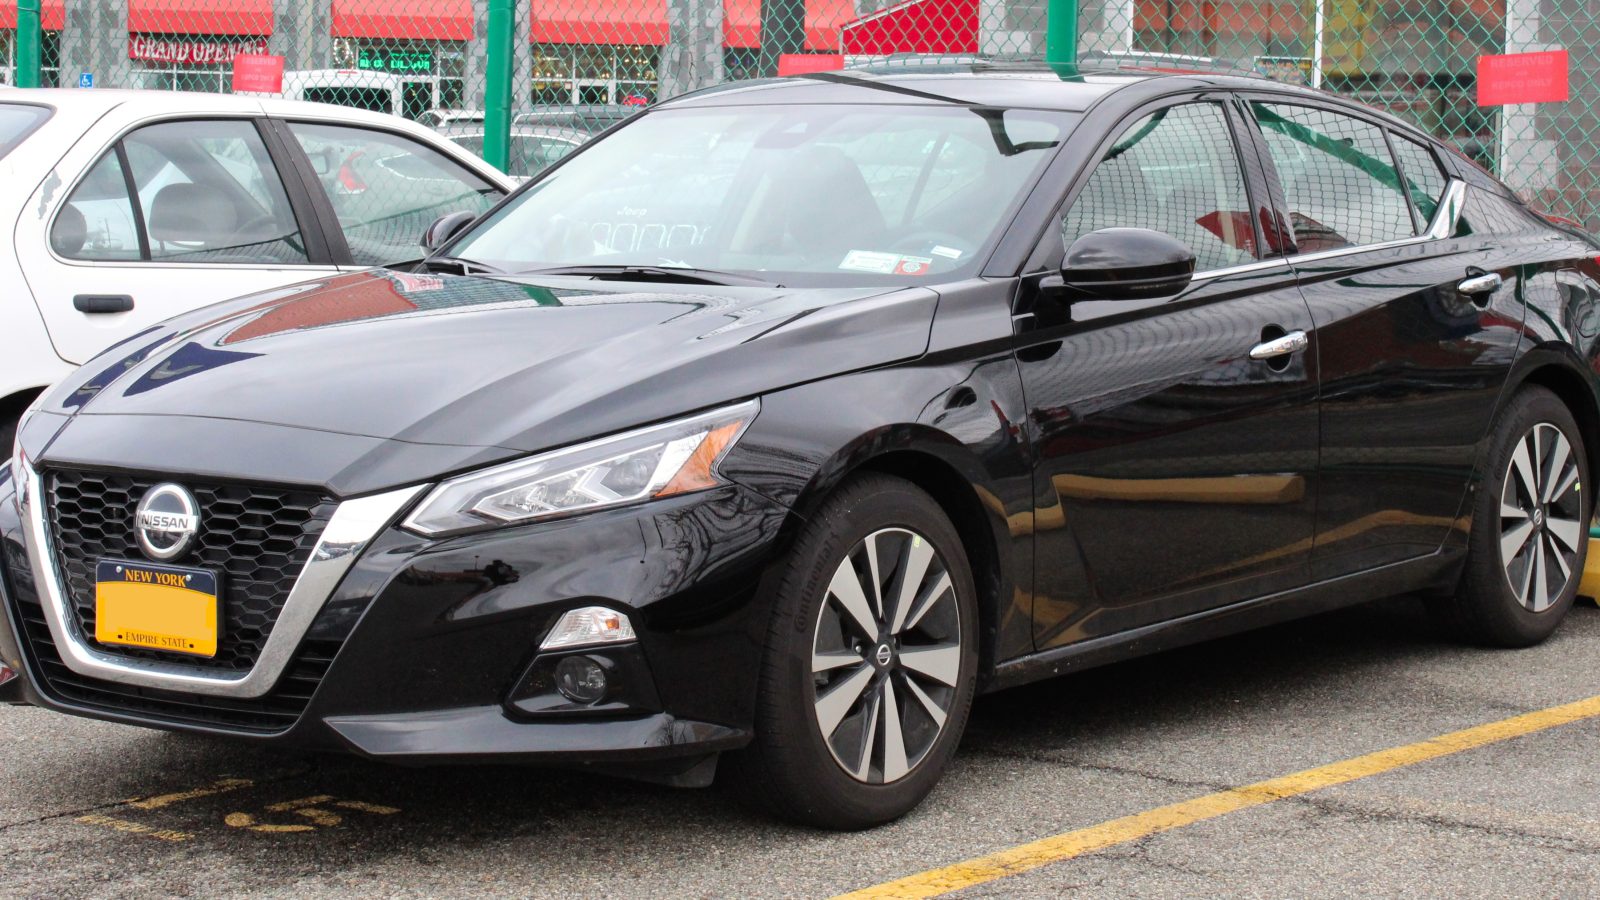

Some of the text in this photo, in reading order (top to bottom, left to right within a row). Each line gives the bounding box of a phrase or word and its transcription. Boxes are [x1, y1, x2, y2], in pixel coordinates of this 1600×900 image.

[134, 35, 189, 61] GRAND
[1490, 55, 1554, 68] RESERVED
[617, 205, 647, 217] Jeep
[141, 514, 189, 530] NISSAN
[125, 569, 187, 588] NEW YORK
[125, 632, 188, 649] EMPIRE STATE
